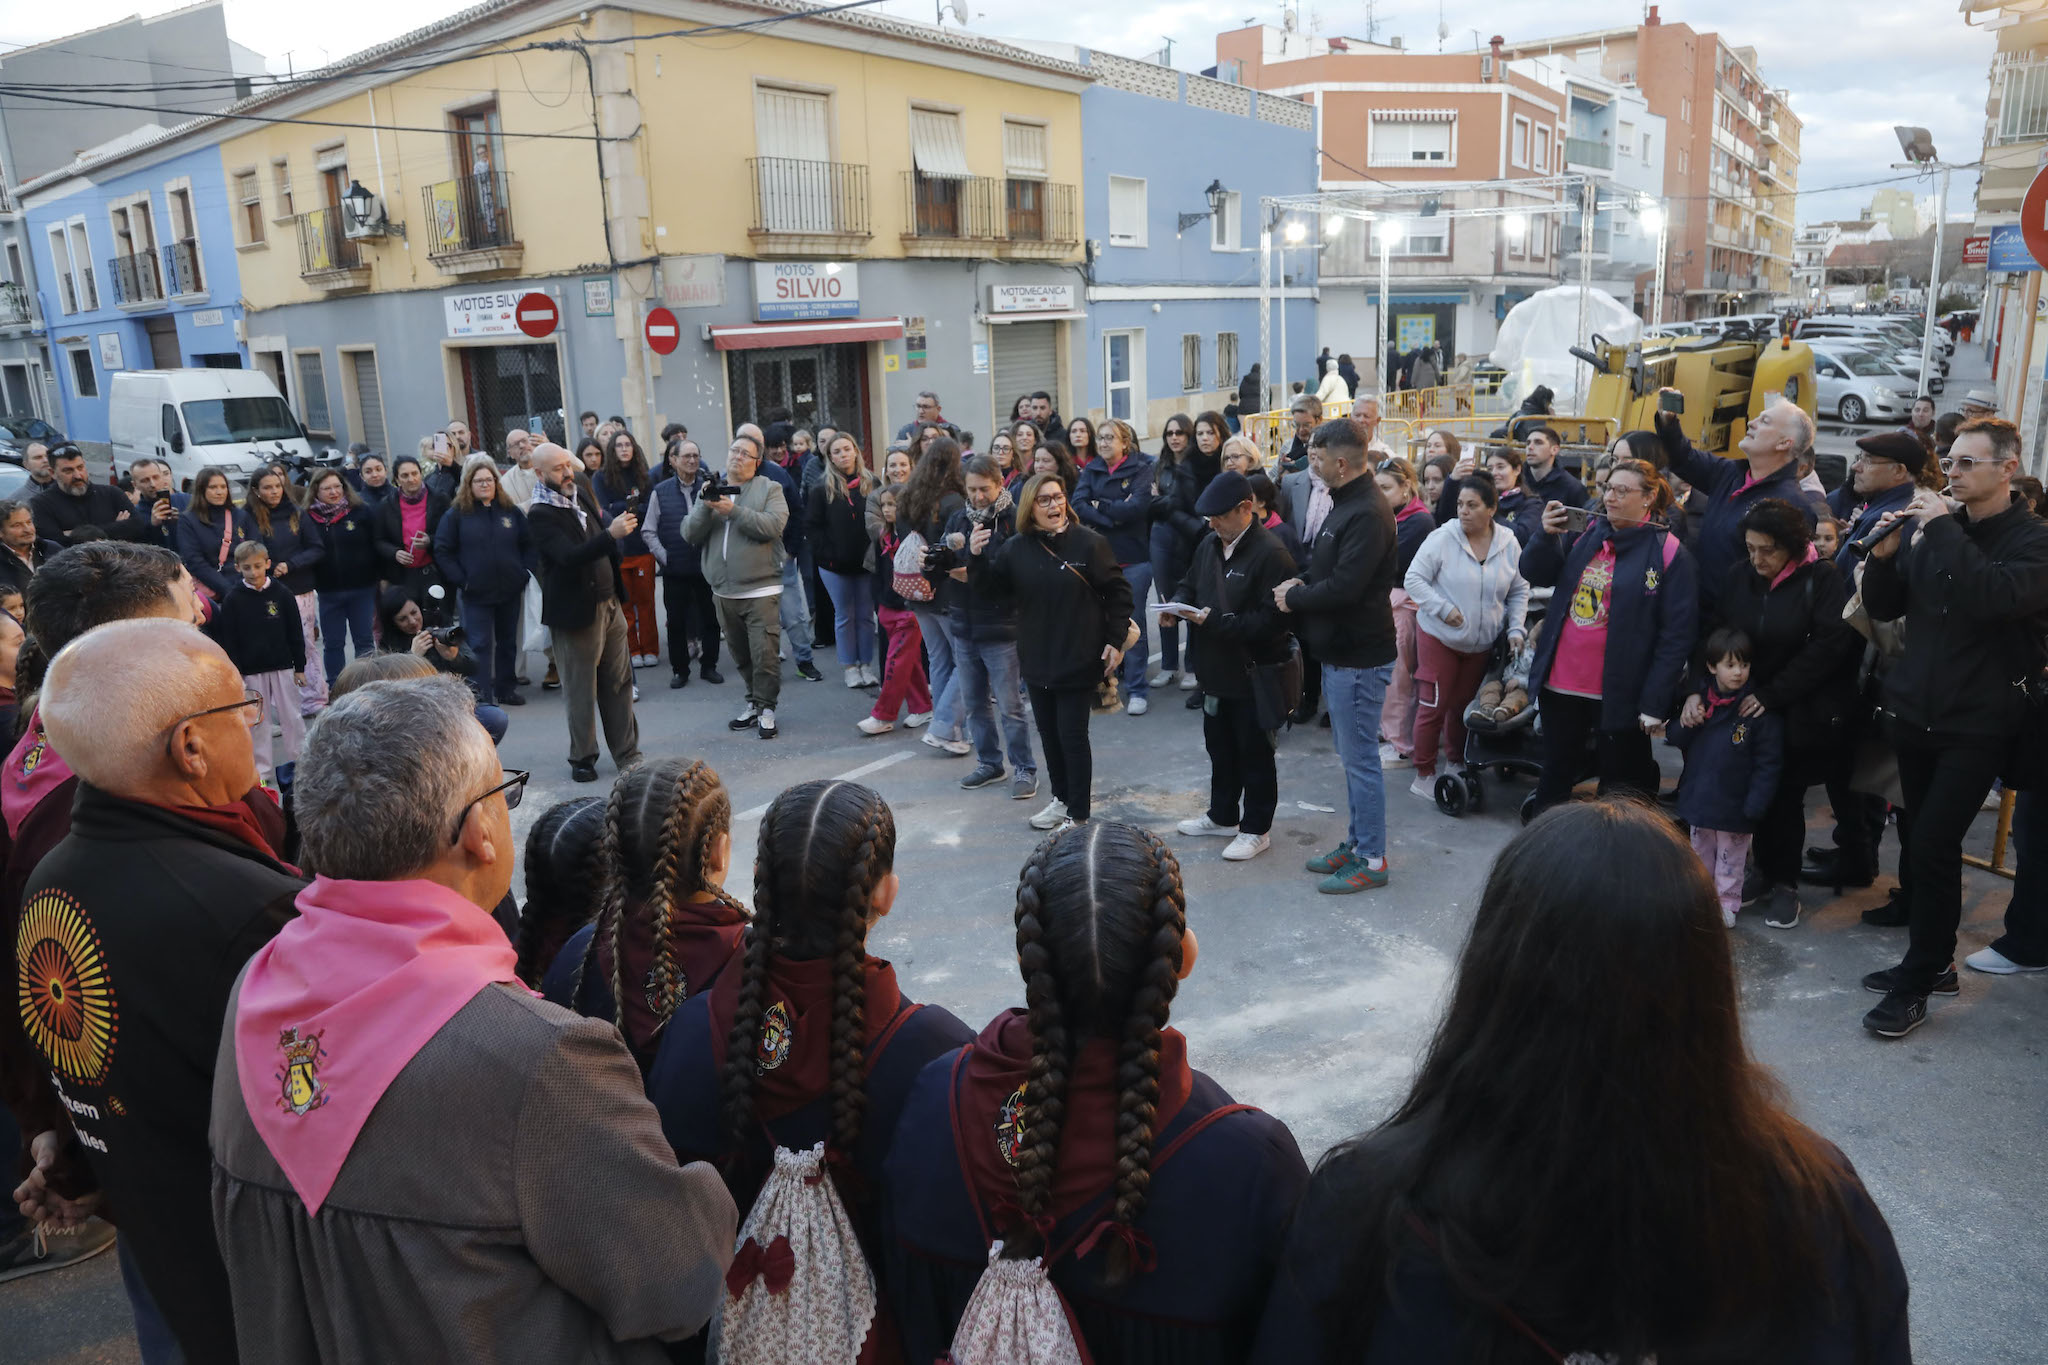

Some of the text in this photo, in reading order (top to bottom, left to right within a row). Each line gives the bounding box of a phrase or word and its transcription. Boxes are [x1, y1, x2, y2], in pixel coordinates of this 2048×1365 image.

[775, 264, 815, 276] MOTOS
[664, 282, 717, 302] YAMAHA
[776, 277, 841, 299] SILVIO
[1001, 286, 1066, 296] MOTOMECANICA
[453, 292, 531, 312] MOTOS SILV
